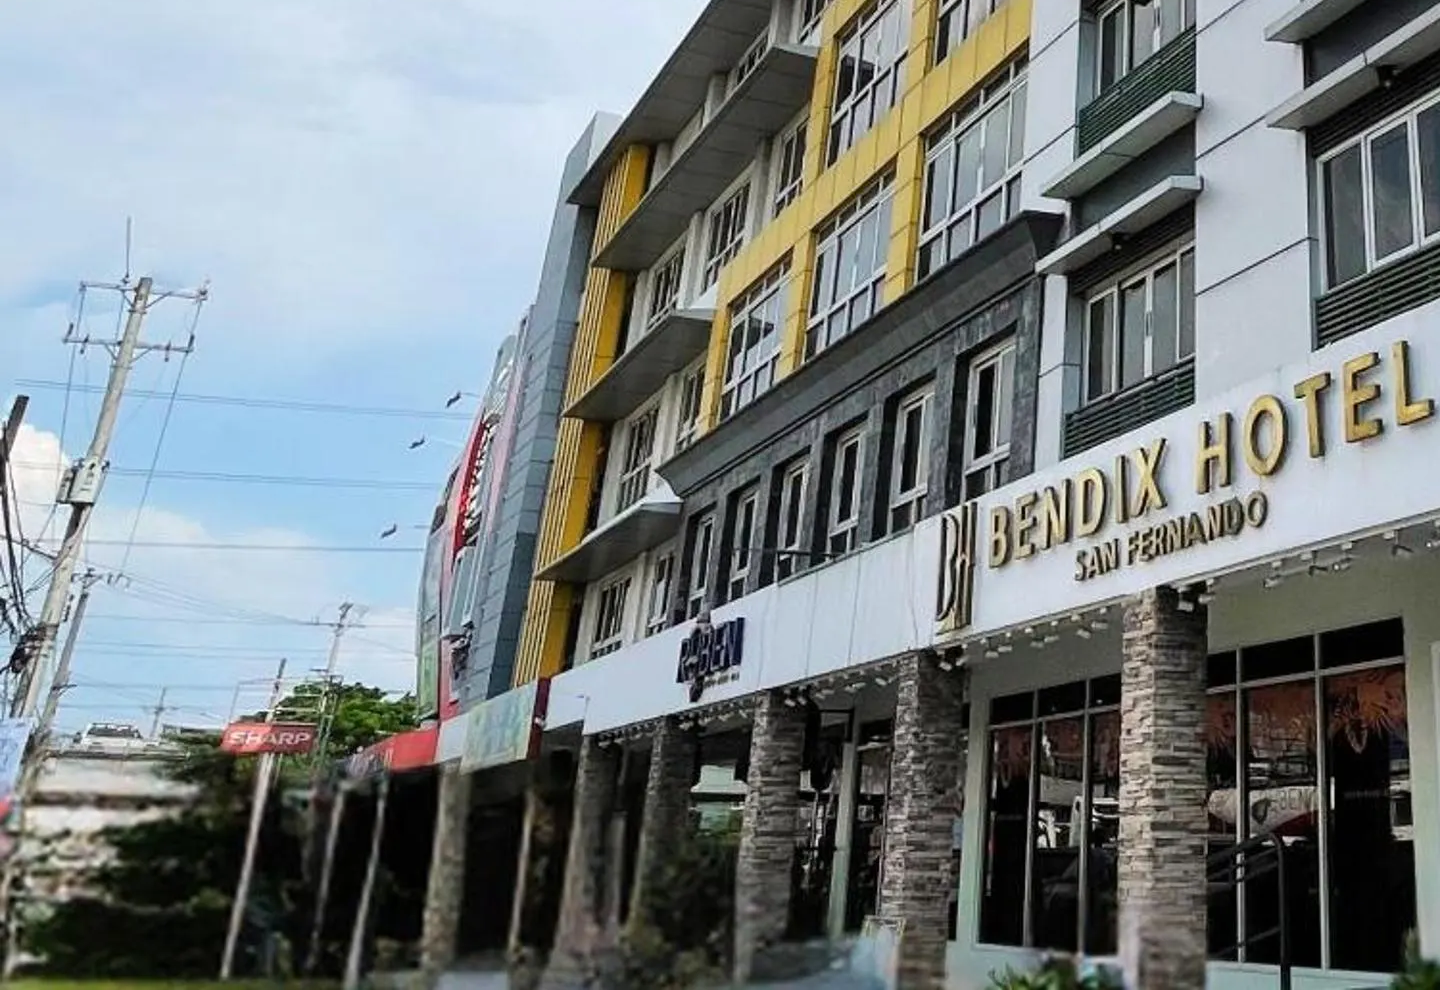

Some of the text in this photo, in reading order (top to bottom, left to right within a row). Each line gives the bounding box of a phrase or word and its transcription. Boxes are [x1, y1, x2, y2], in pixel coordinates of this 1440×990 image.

[988, 340, 1436, 570] BENDIX HOTEL
[1075, 490, 1269, 582] SAN FERNANDO
[230, 730, 311, 747] SHARP
